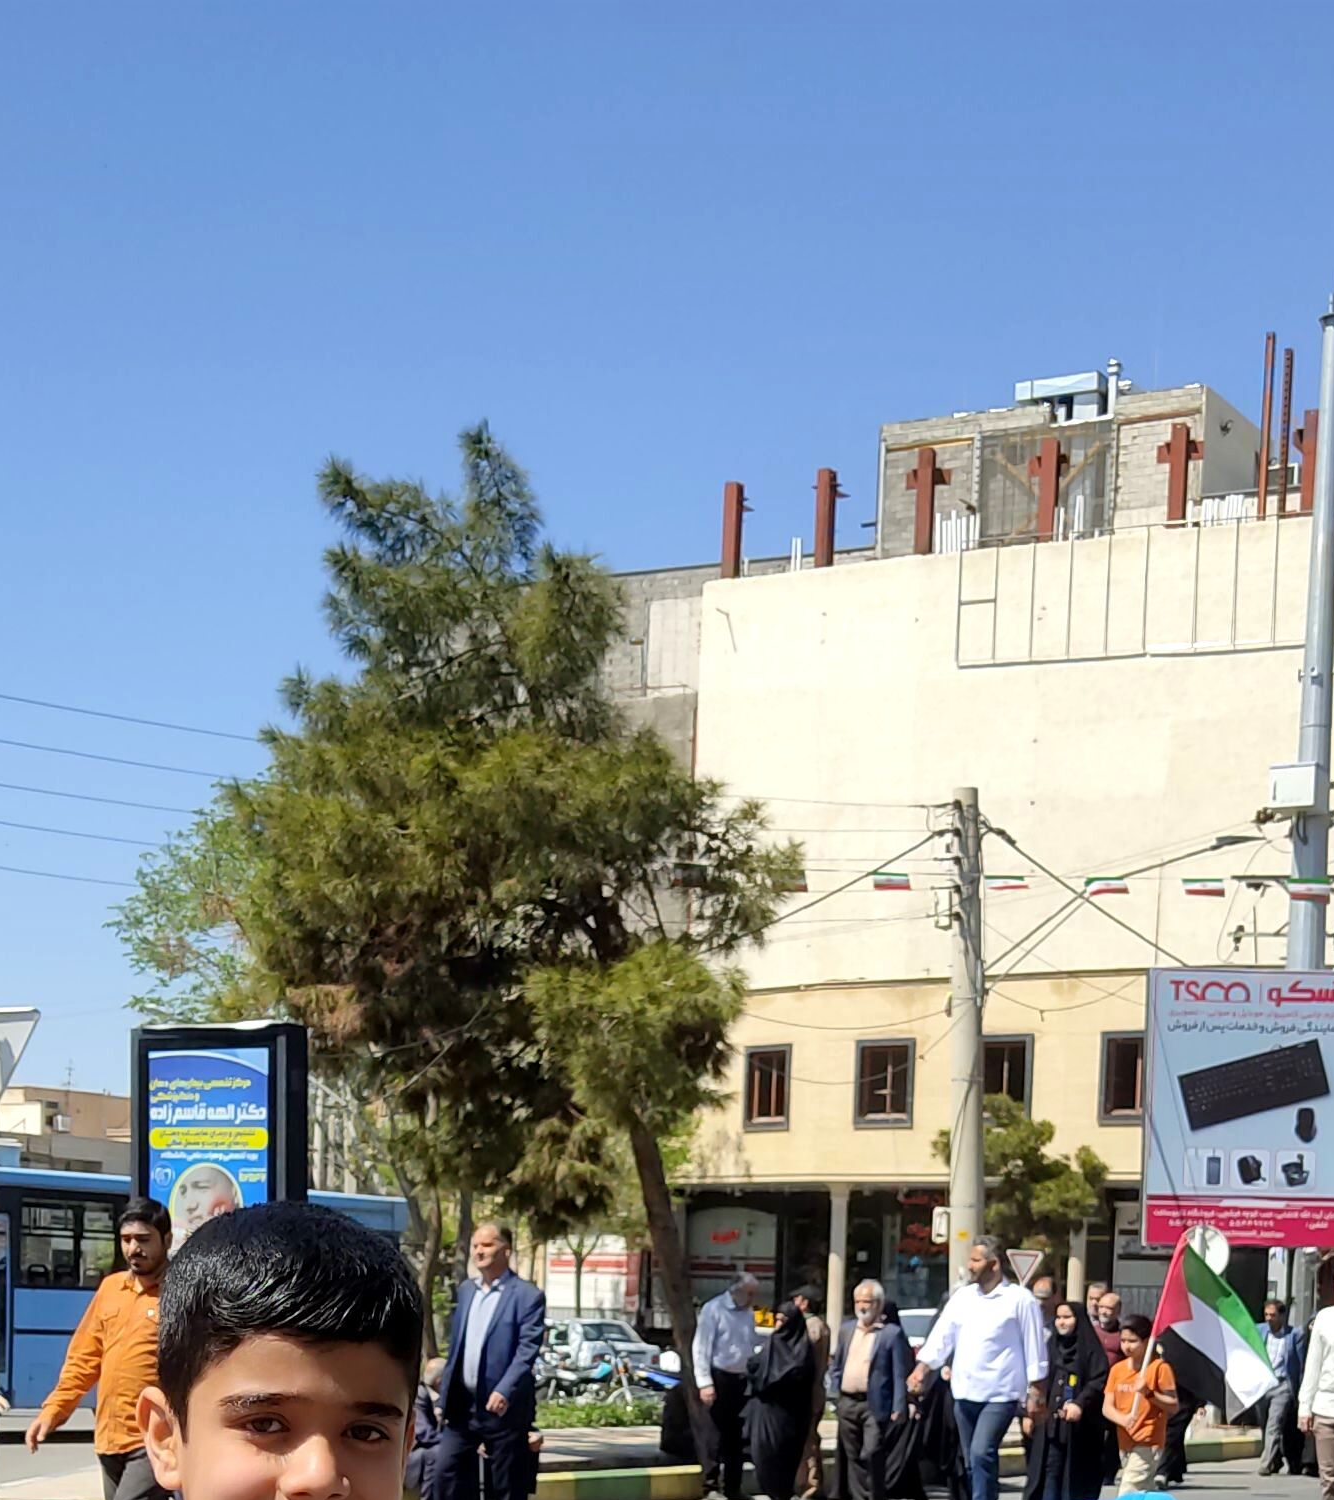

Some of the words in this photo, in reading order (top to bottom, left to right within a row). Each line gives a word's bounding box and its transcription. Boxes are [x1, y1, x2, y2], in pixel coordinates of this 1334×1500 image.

[1169, 979, 1252, 1003] TSCO
[1167, 1019, 1198, 1032] فروش
[1267, 1021, 1296, 1034] فروش
[149, 1102, 173, 1125] زاده
[172, 1102, 207, 1125] قاسم
[207, 1103, 235, 1121] الهه
[234, 1102, 267, 1125] دکتر
